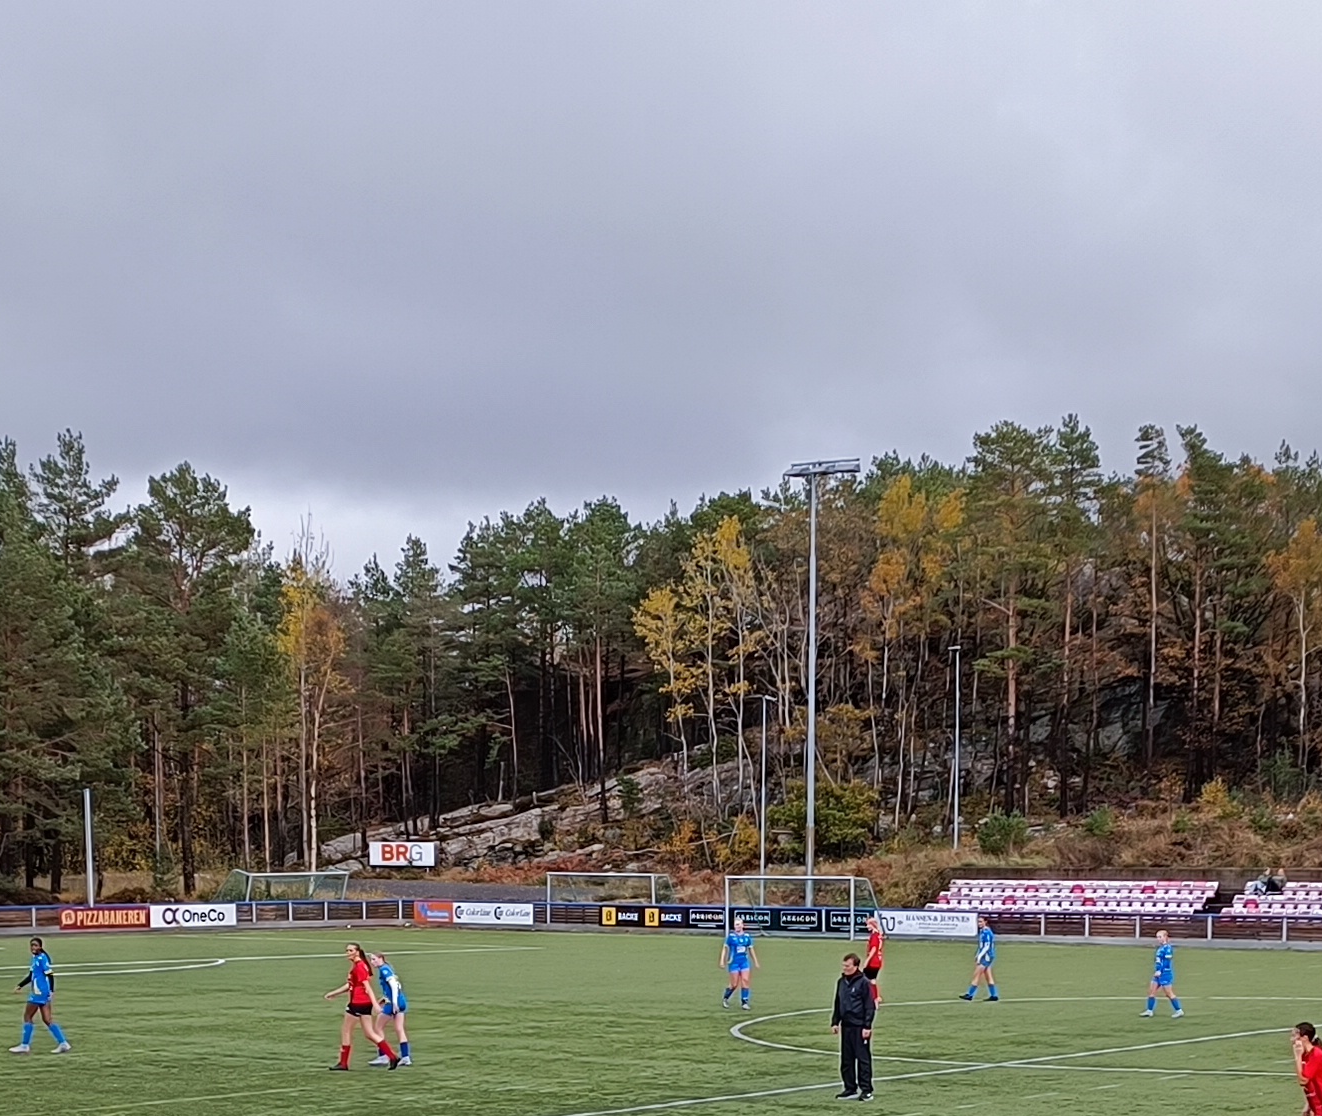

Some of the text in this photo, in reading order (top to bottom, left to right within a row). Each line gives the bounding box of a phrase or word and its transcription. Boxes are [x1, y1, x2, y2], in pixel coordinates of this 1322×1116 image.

[381, 844, 423, 861] BRG
[78, 910, 146, 925] PIZZABAKEREN
[182, 909, 225, 923] OneCo
